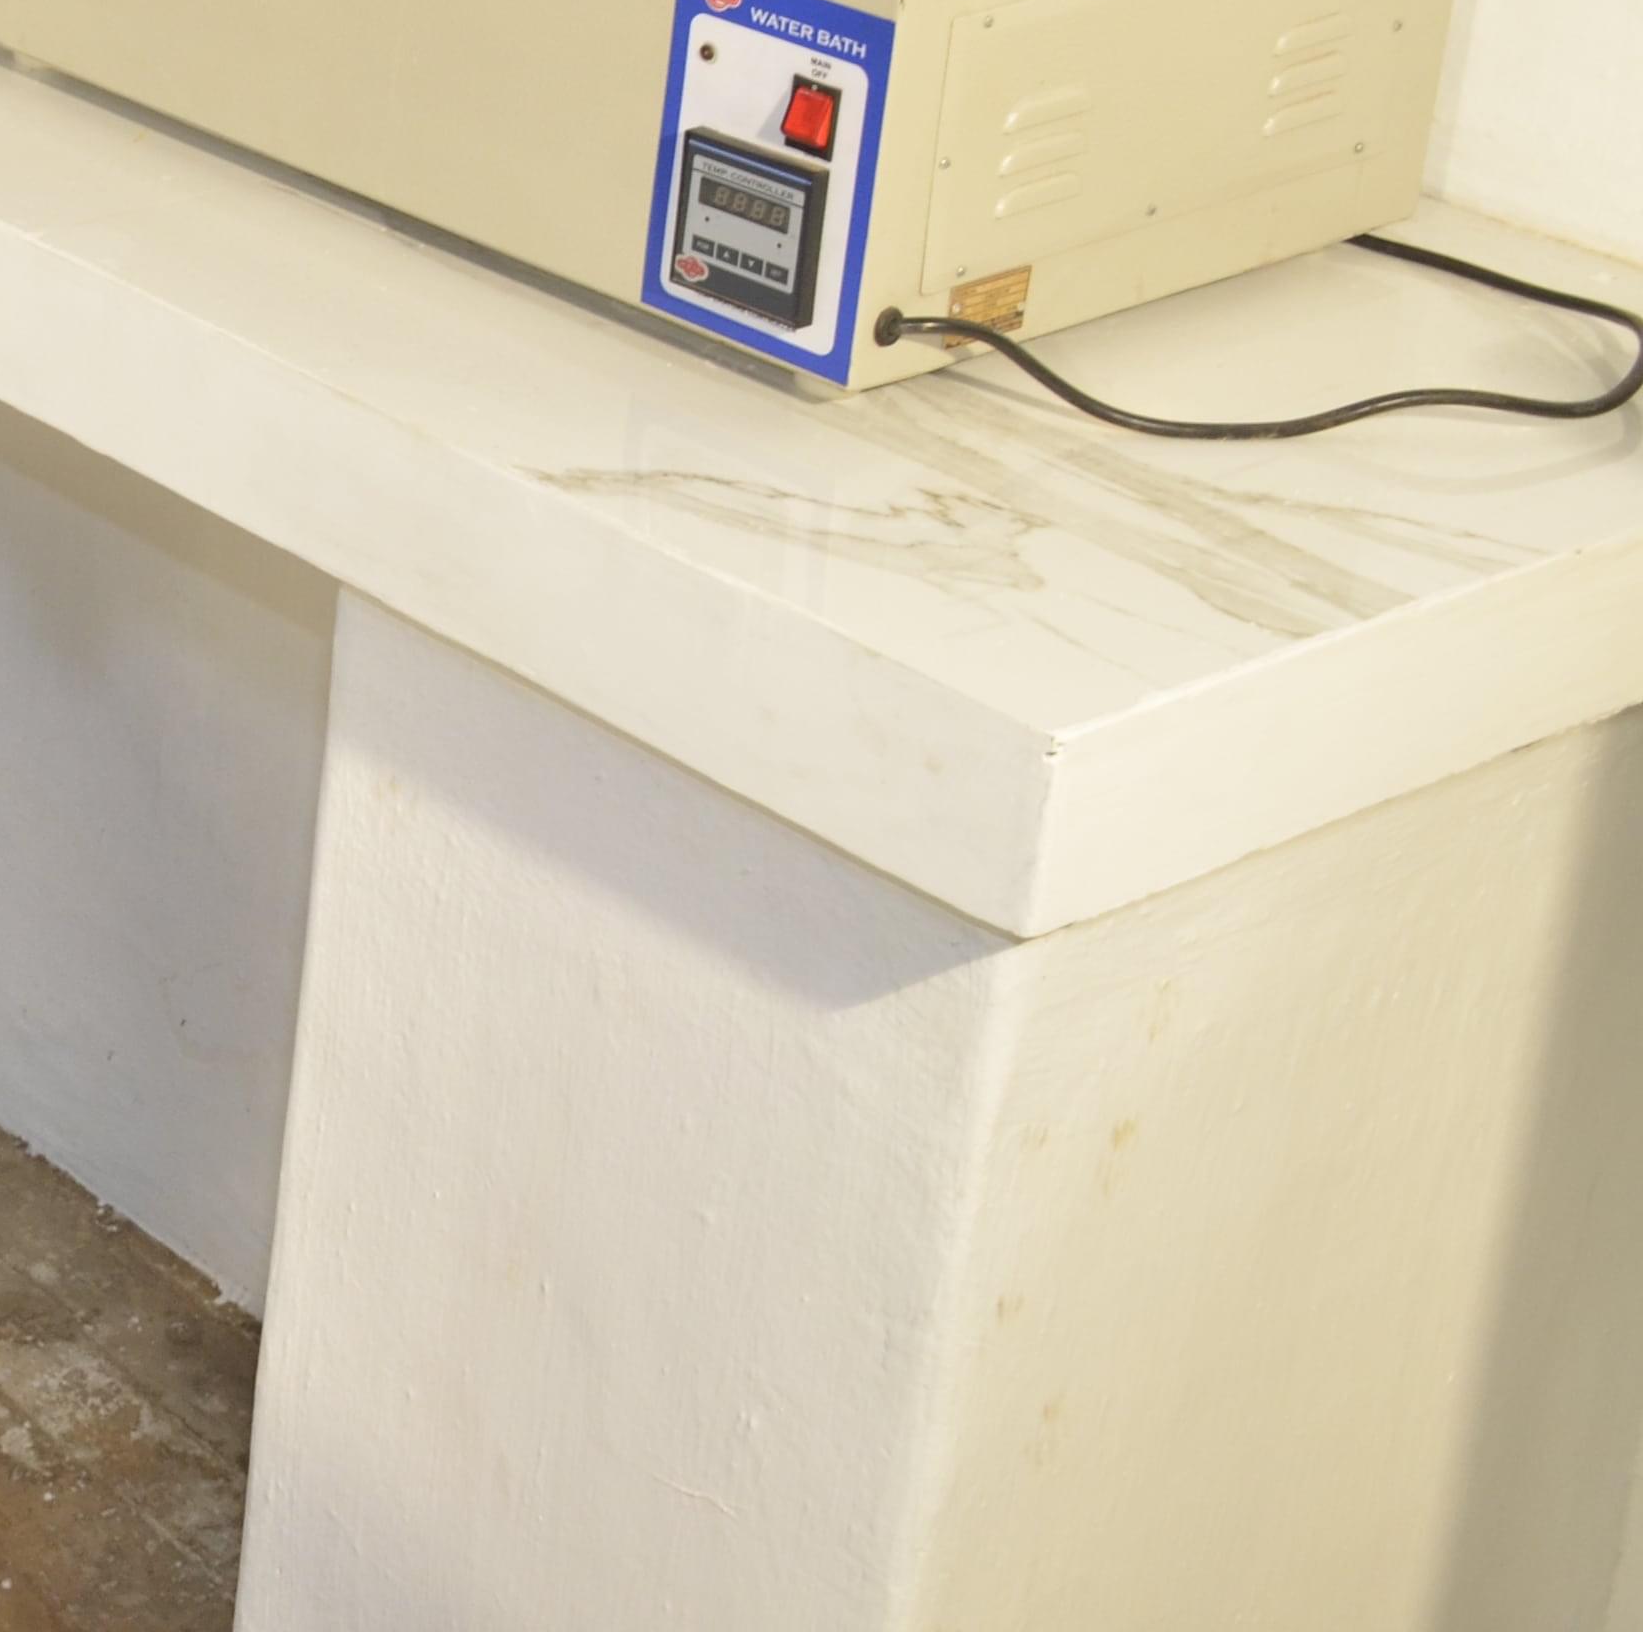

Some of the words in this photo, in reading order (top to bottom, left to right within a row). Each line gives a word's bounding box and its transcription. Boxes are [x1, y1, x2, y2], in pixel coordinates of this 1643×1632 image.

[750, 6, 814, 42] WATER
[815, 28, 868, 60] BATH
[810, 57, 833, 70] MAIN
[811, 68, 829, 80] OFF
[730, 172, 795, 201] CONTROLLER
